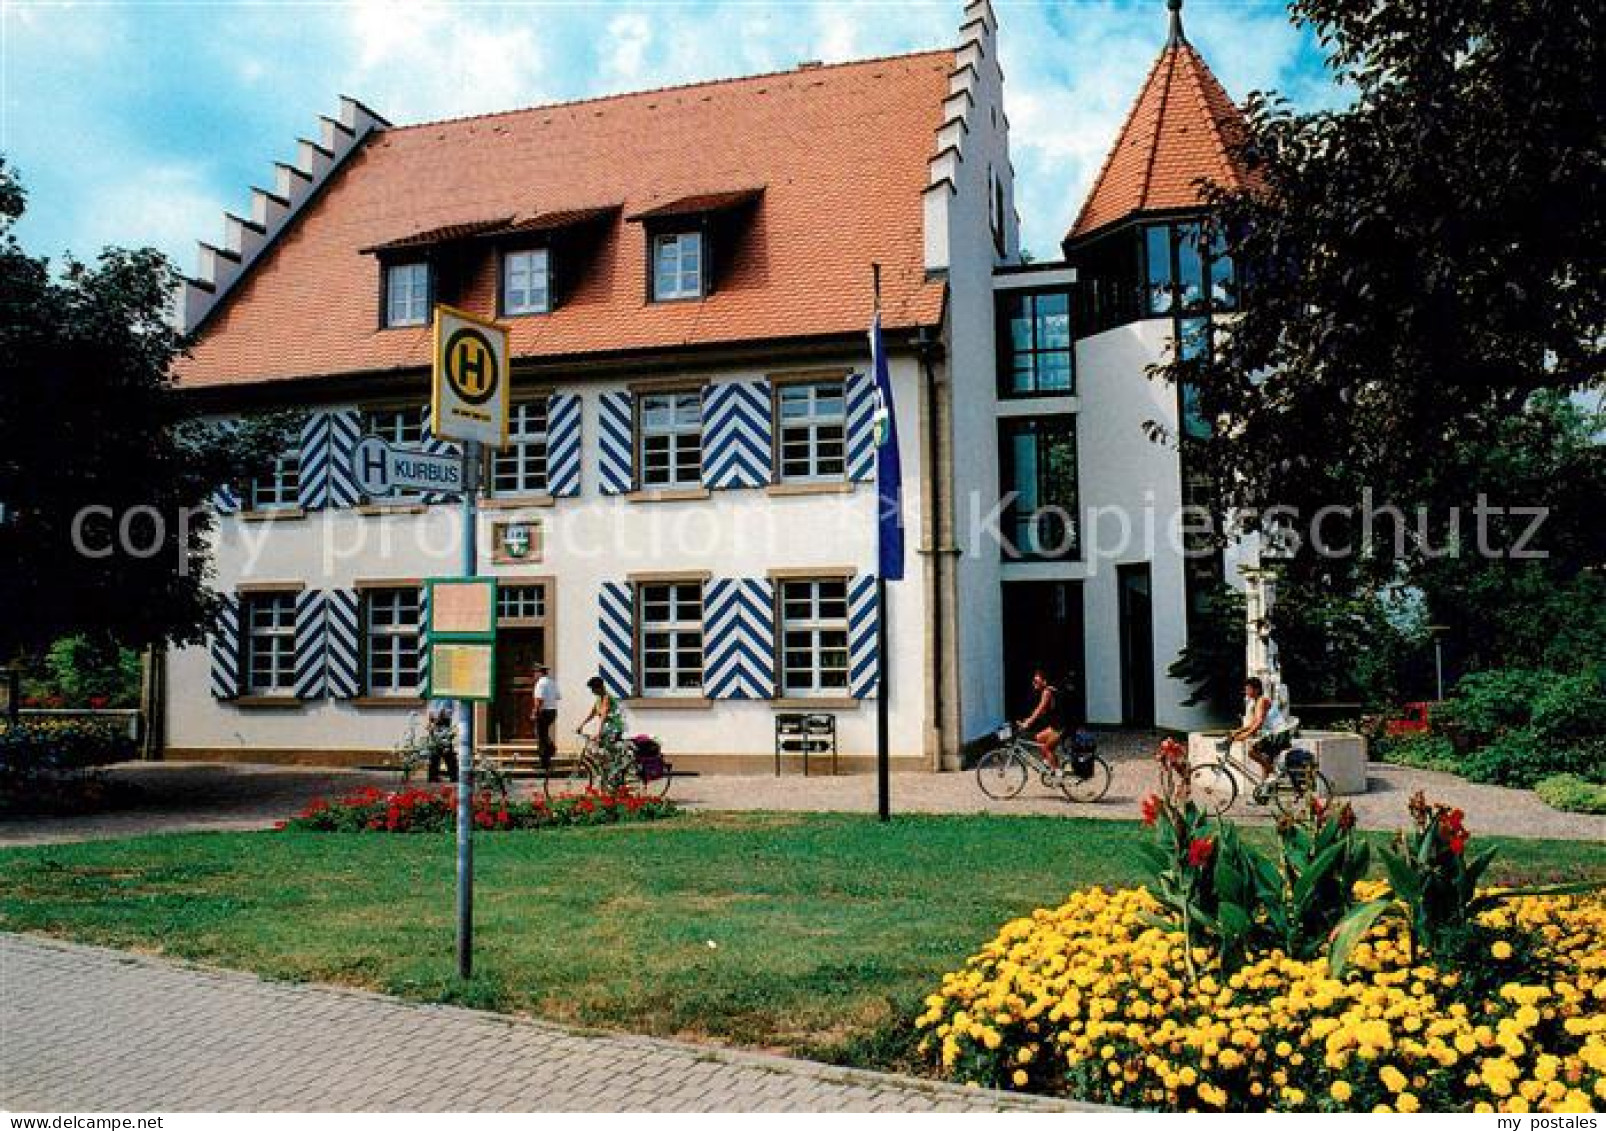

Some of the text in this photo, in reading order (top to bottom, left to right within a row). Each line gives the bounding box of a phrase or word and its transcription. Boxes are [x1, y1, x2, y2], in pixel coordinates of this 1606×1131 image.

[459, 343, 485, 391] H
[362, 445, 459, 485] H KURBUS
